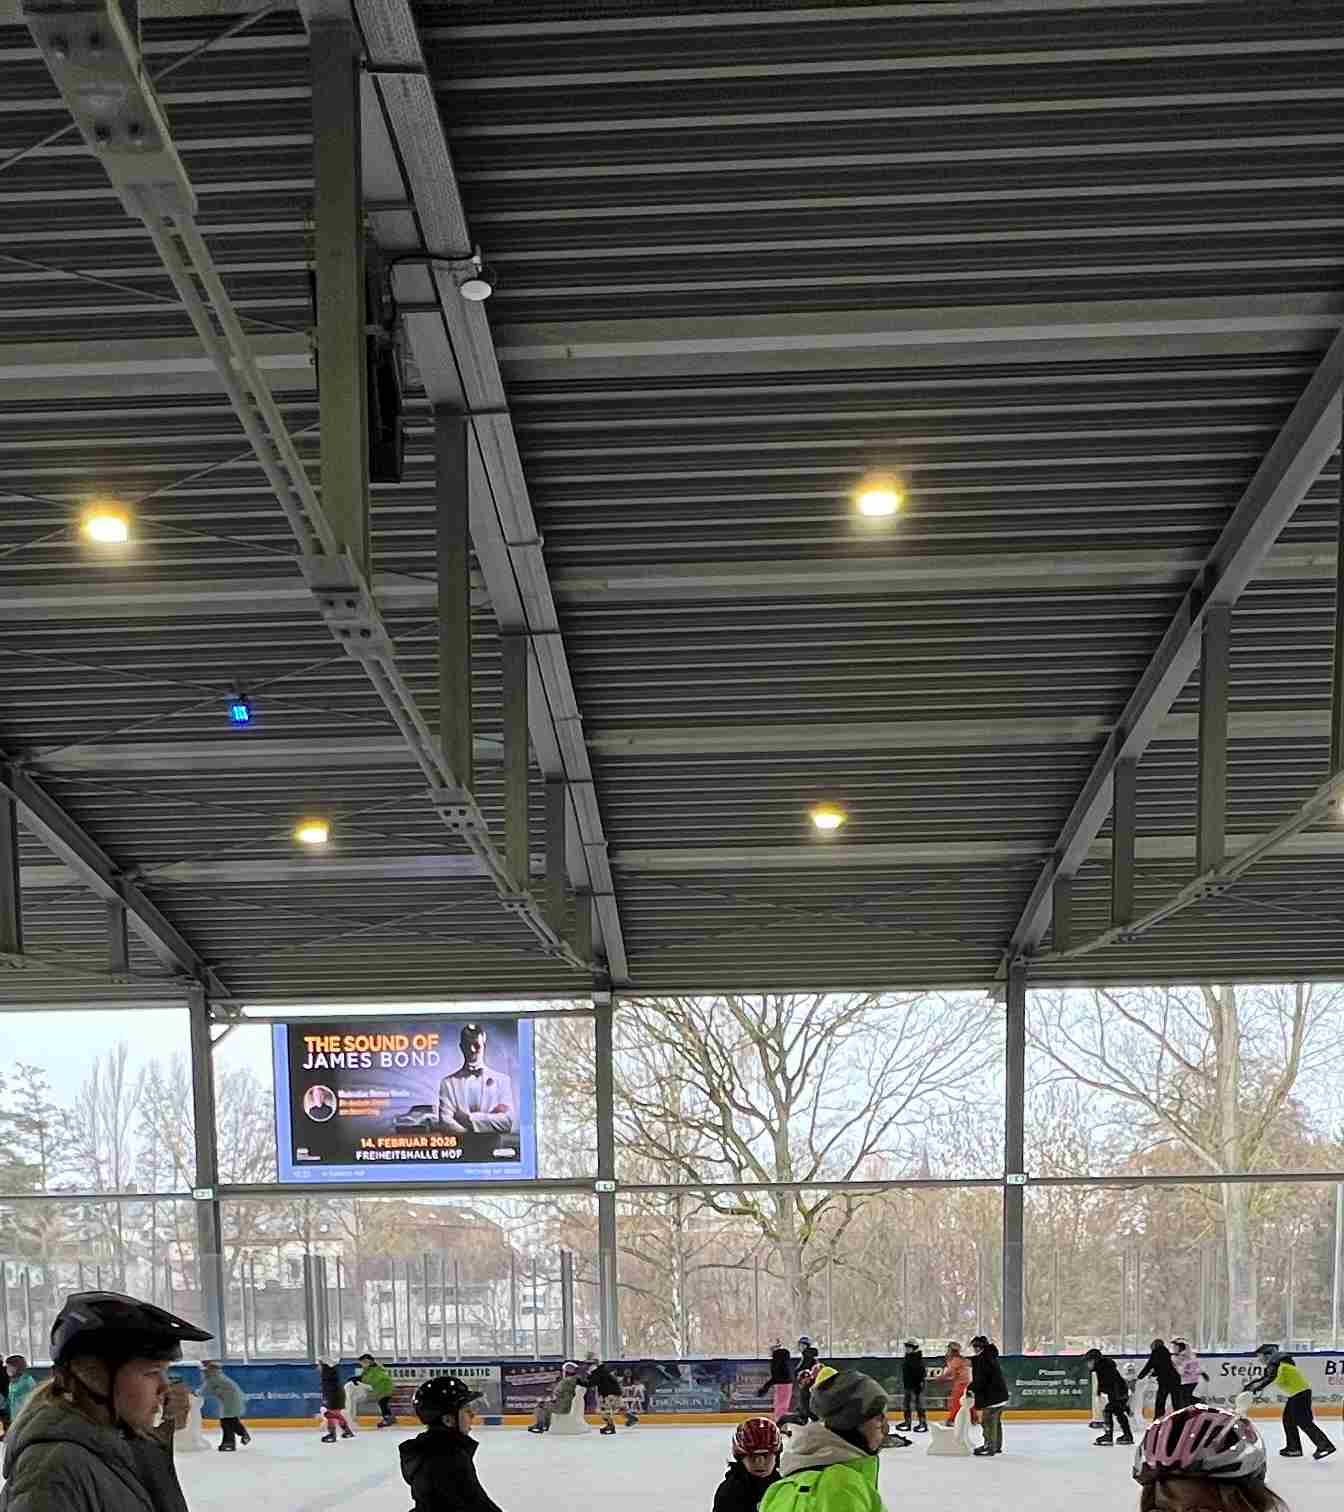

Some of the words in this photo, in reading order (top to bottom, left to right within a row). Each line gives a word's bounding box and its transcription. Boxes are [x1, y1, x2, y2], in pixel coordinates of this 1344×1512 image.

[304, 1036, 340, 1052] THE
[343, 1035, 409, 1051] SOUND
[413, 1034, 440, 1050] OF
[303, 1052, 372, 1069] JAMES
[380, 1051, 440, 1068] BOND
[378, 1137, 428, 1148] FEBRUAR
[356, 1150, 439, 1160] FREIHEITSHALLE
[441, 1149, 463, 1159] HOF
